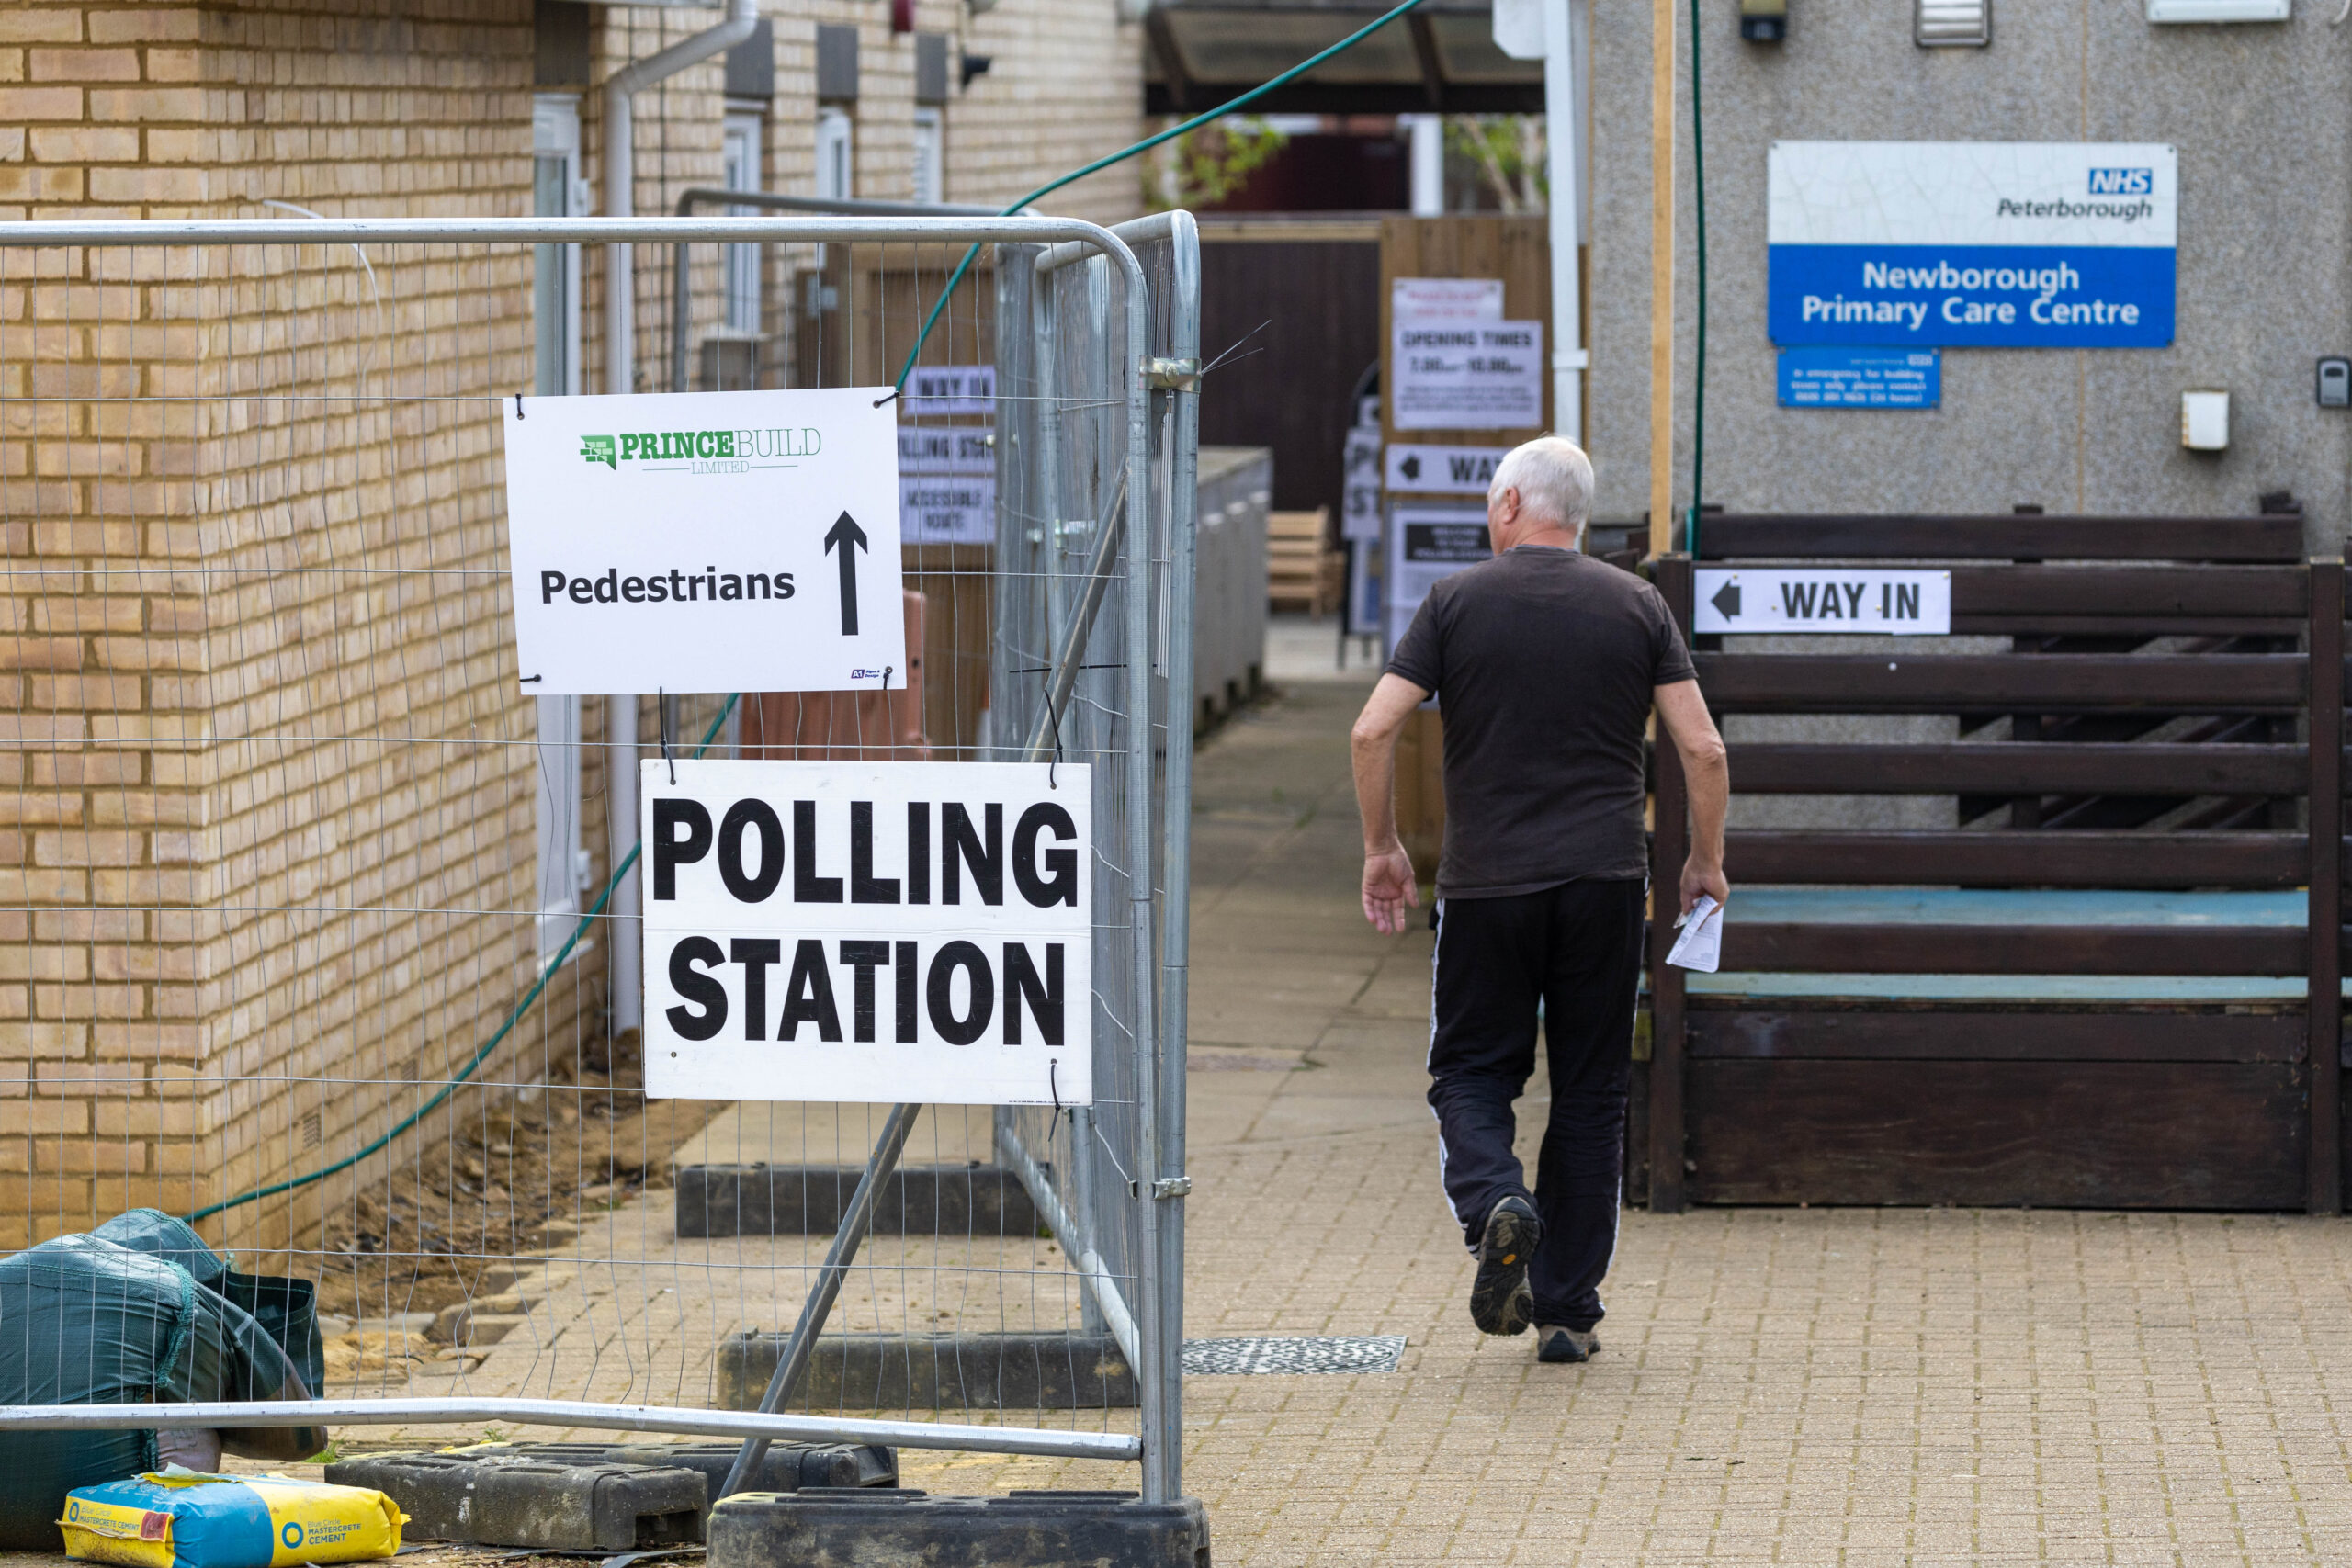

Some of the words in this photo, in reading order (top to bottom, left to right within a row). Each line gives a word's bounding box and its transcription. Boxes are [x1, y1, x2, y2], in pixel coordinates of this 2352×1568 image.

[2090, 171, 2151, 194] NHS
[1996, 198, 2152, 221] Peterborough
[1863, 261, 2079, 297] Newborough
[1803, 295, 1928, 330] Primary
[1941, 297, 2016, 324] Care
[2030, 298, 2140, 325] Centre
[1402, 331, 1477, 348] OPENING
[1483, 331, 1532, 348] TIMES
[921, 378, 961, 401] WAY
[691, 460, 750, 475] LIMITED
[541, 566, 796, 604] Pedestrians
[1781, 582, 1866, 618] WAY
[1883, 582, 1920, 619] IN
[653, 798, 1078, 908] POLLING
[665, 936, 1065, 1046] STATION
[79, 1516, 117, 1528] MASTERCRETE
[118, 1520, 140, 1531] CEMENT
[308, 1523, 361, 1535] MASTERCRETE
[323, 1517, 341, 1527] Circle
[309, 1533, 346, 1545] CEMENT
